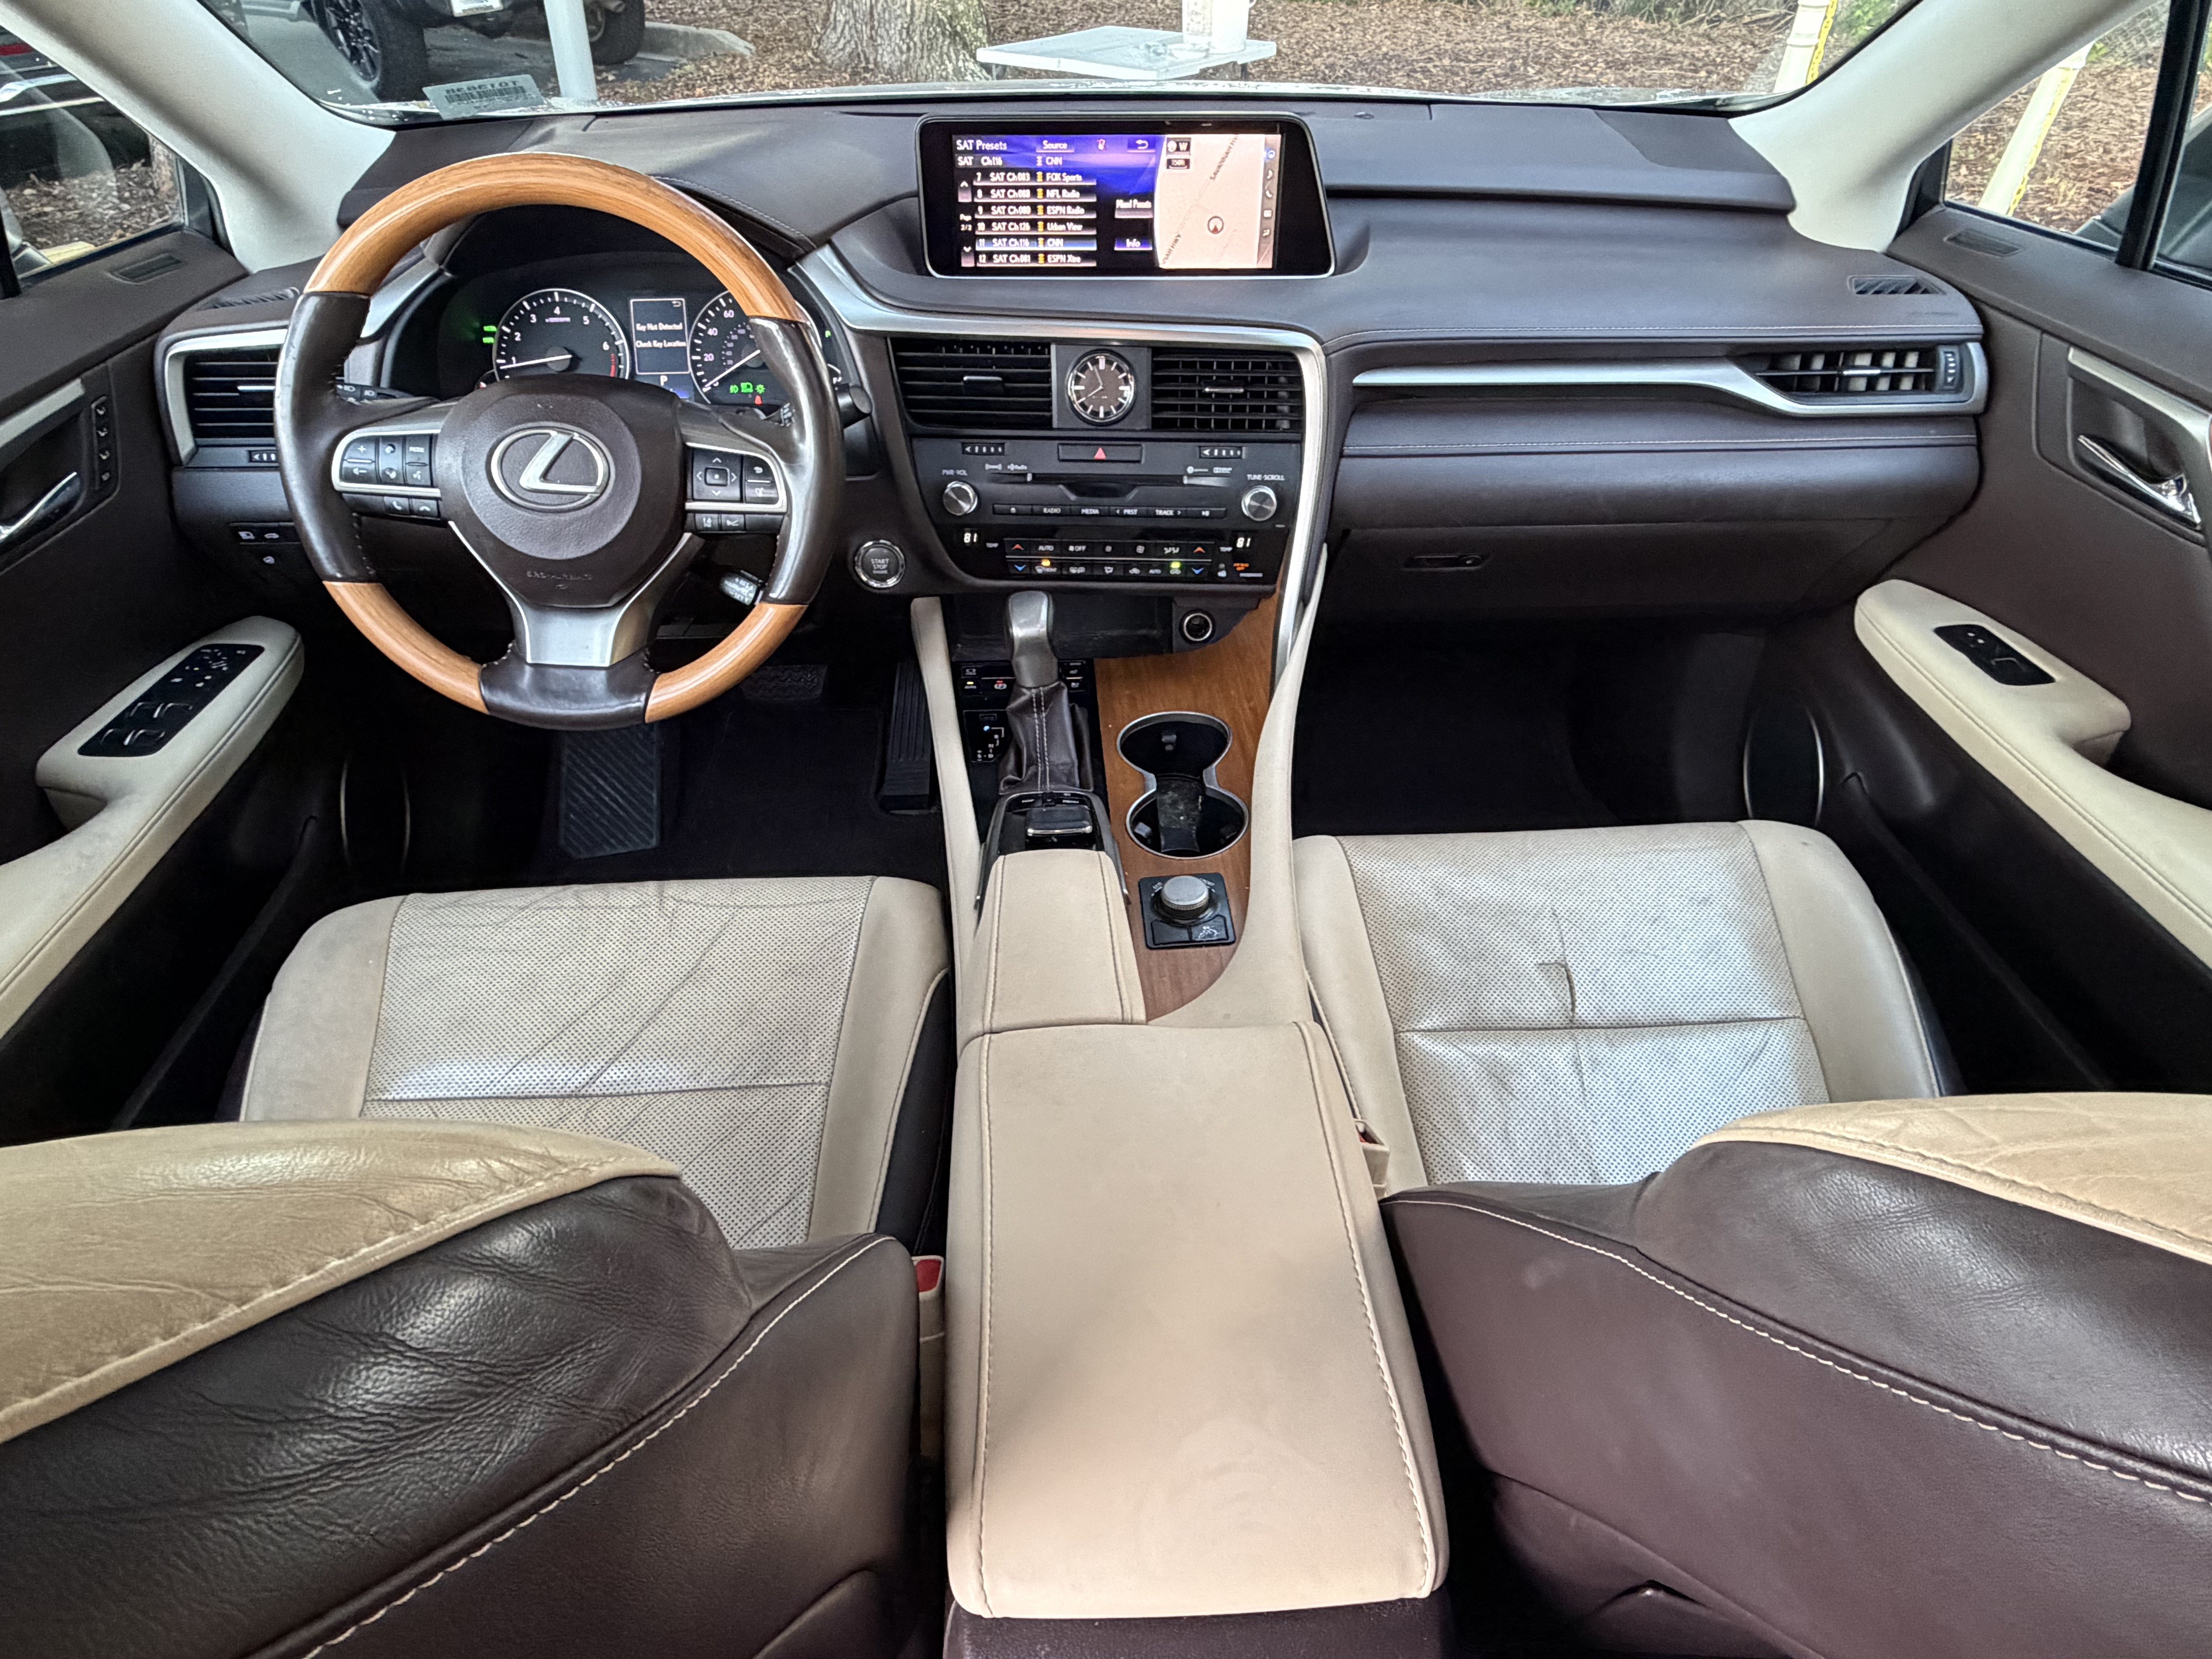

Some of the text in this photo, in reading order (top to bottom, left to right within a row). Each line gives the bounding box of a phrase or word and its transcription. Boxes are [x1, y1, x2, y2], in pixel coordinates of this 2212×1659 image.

[956, 140, 1007, 151] SAT Presets
[1043, 140, 1067, 149] Source
[1179, 142, 1188, 151] W
[958, 156, 1063, 165] SAT Ch116 CNN
[990, 172, 1005, 182] SAT
[1046, 173, 1061, 181] FOX
[990, 189, 1006, 198] SAT
[1046, 189, 1061, 198] NFL
[991, 206, 1006, 215] SAT
[1047, 206, 1065, 215] ESPN
[977, 222, 985, 231] 10
[992, 222, 1007, 231] SAT
[1066, 222, 1083, 231] View
[979, 239, 985, 247] 11
[992, 239, 1007, 247] SAT
[1047, 239, 1063, 247] CNN
[1126, 239, 1140, 248] Info
[979, 254, 986, 263] 12
[993, 254, 1008, 263] SAT
[1048, 254, 1066, 263] ESPN
[553, 306, 560, 315] 4
[724, 310, 734, 318] 60
[530, 314, 536, 323] 3
[583, 316, 589, 325] 5
[636, 323, 646, 331] Key
[514, 331, 521, 341] 2
[708, 328, 718, 336] 40
[603, 342, 610, 350] 6
[653, 340, 663, 349] Key
[512, 357, 516, 365] 1
[704, 353, 714, 361] 20
[660, 375, 668, 386] P
[964, 533, 978, 543] 81
[1237, 538, 1251, 548] 81
